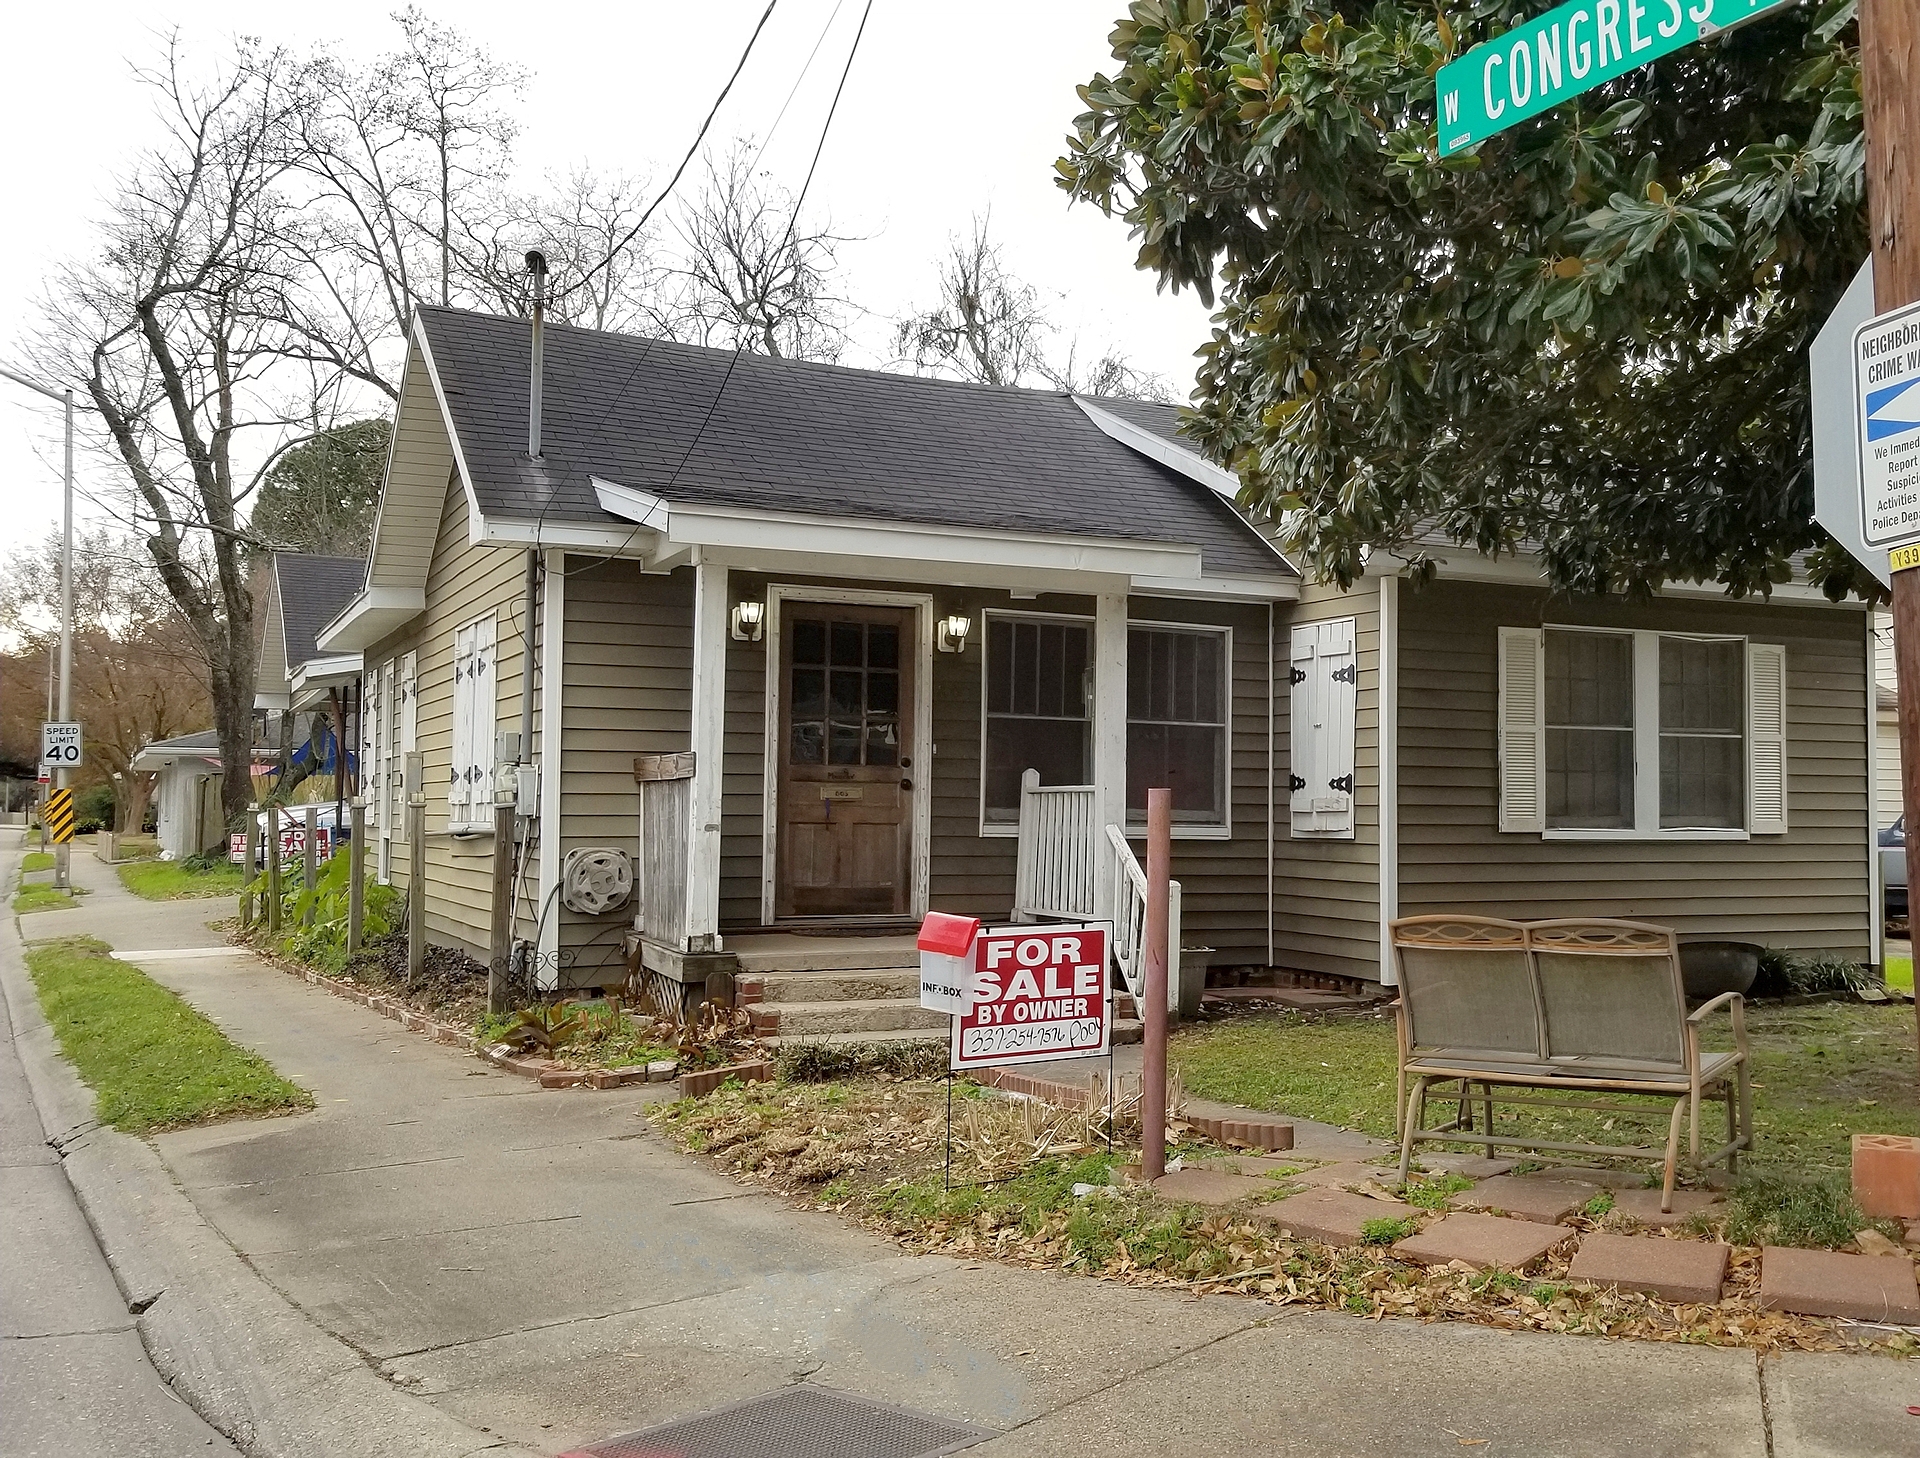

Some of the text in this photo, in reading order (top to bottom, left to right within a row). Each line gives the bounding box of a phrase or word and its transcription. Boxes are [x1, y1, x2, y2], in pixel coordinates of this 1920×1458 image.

[1443, 89, 1460, 126] W
[1862, 322, 1920, 360] NEIGHBOR
[1868, 355, 1903, 384] CRIME
[1874, 447, 1888, 460] We
[1888, 455, 1918, 474] Report
[1887, 472, 1920, 492] Suspici
[1877, 492, 1917, 512] Activities
[1872, 515, 1899, 531] Police
[1896, 548, 1919, 567] Y39
[46, 727, 79, 735] SPEED
[49, 736, 75, 744] LIMIT
[46, 745, 79, 761] 40
[280, 831, 318, 841] FO
[279, 840, 325, 852] SAE
[986, 937, 1082, 969] FOR
[974, 964, 1100, 1004] SALE
[977, 998, 1088, 1025] BY OWNER
